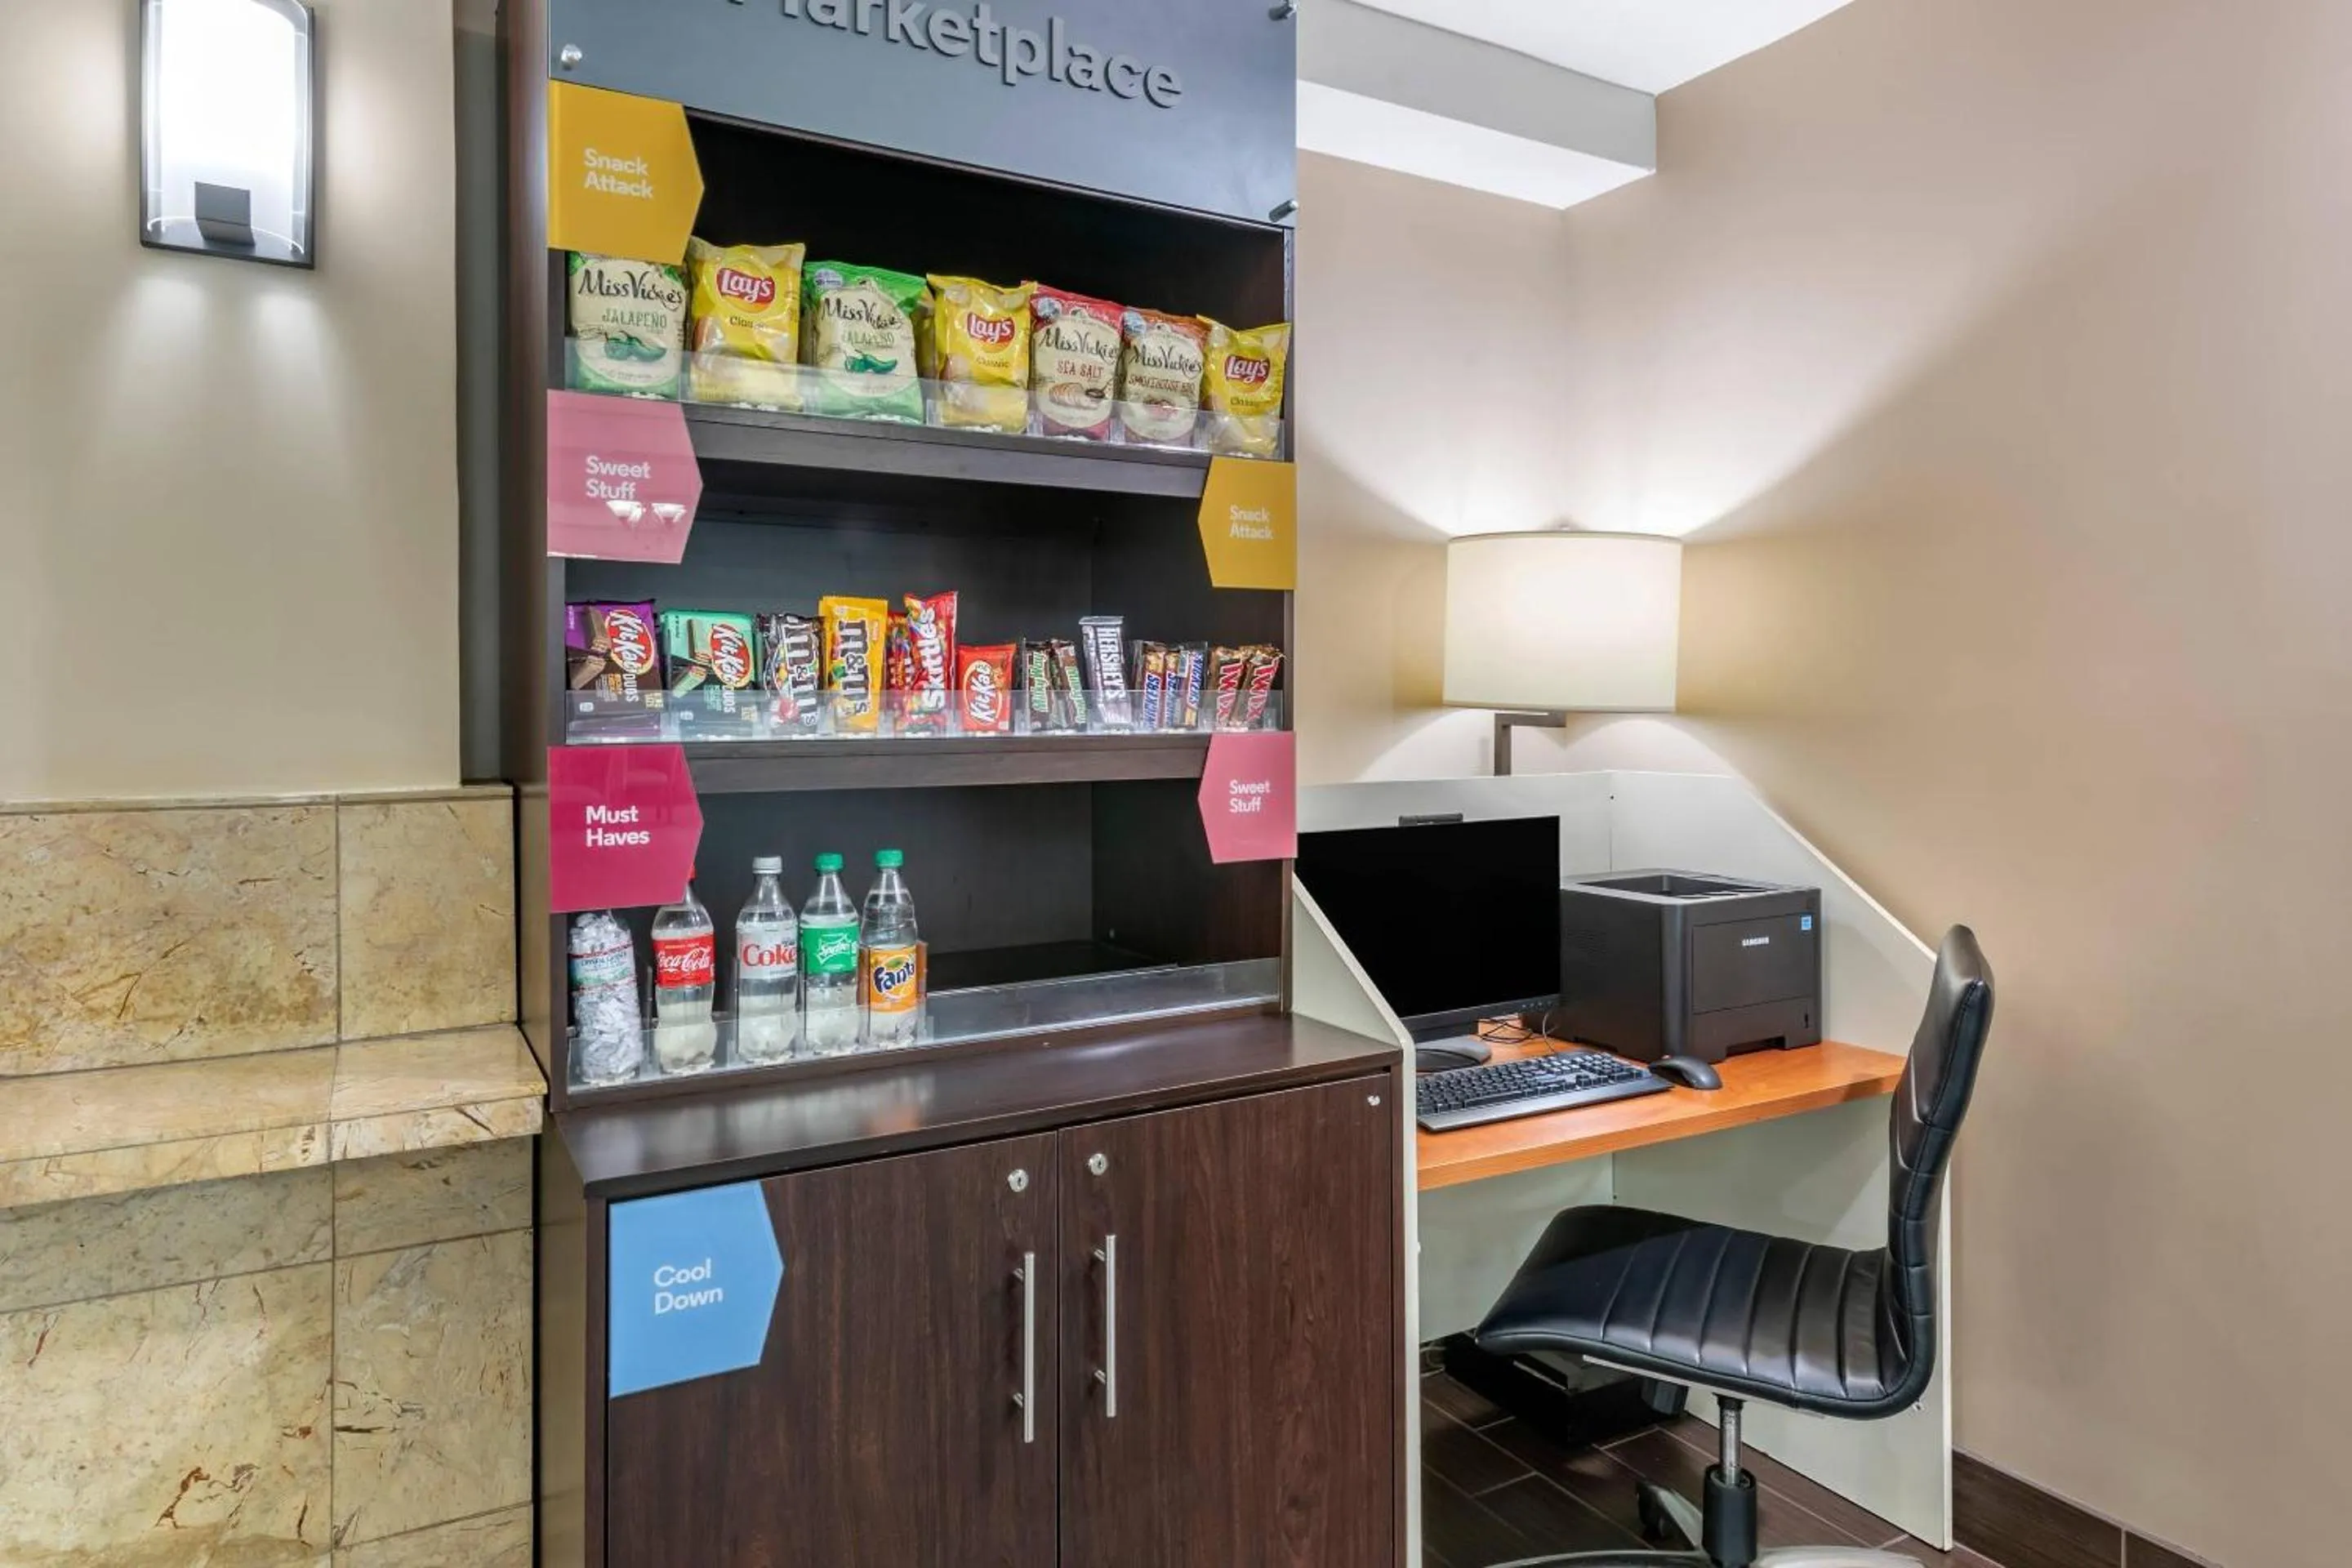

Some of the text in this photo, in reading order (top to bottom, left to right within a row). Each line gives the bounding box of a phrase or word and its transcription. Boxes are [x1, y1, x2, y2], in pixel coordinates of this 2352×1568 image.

[726, 0, 1183, 108] arketplace
[584, 148, 649, 176] Snack
[584, 170, 653, 198] Attack
[578, 270, 629, 296] Miss
[822, 297, 862, 321] Miss
[1039, 327, 1077, 352] Miss
[1129, 345, 1162, 368] Miss
[1058, 360, 1104, 379] SEA SALT
[586, 455, 652, 479] Sweet
[586, 478, 636, 499] Stuff
[1230, 504, 1270, 523] Snack
[1229, 522, 1274, 540] Attack
[622, 673, 639, 703] DUOS
[1229, 779, 1271, 795] Sweet
[586, 805, 639, 825] Must
[1228, 796, 1262, 813] Stuff
[586, 827, 650, 847] Haves
[743, 943, 798, 967] Coke
[654, 1258, 710, 1287] Cool
[655, 1288, 724, 1314] Down
